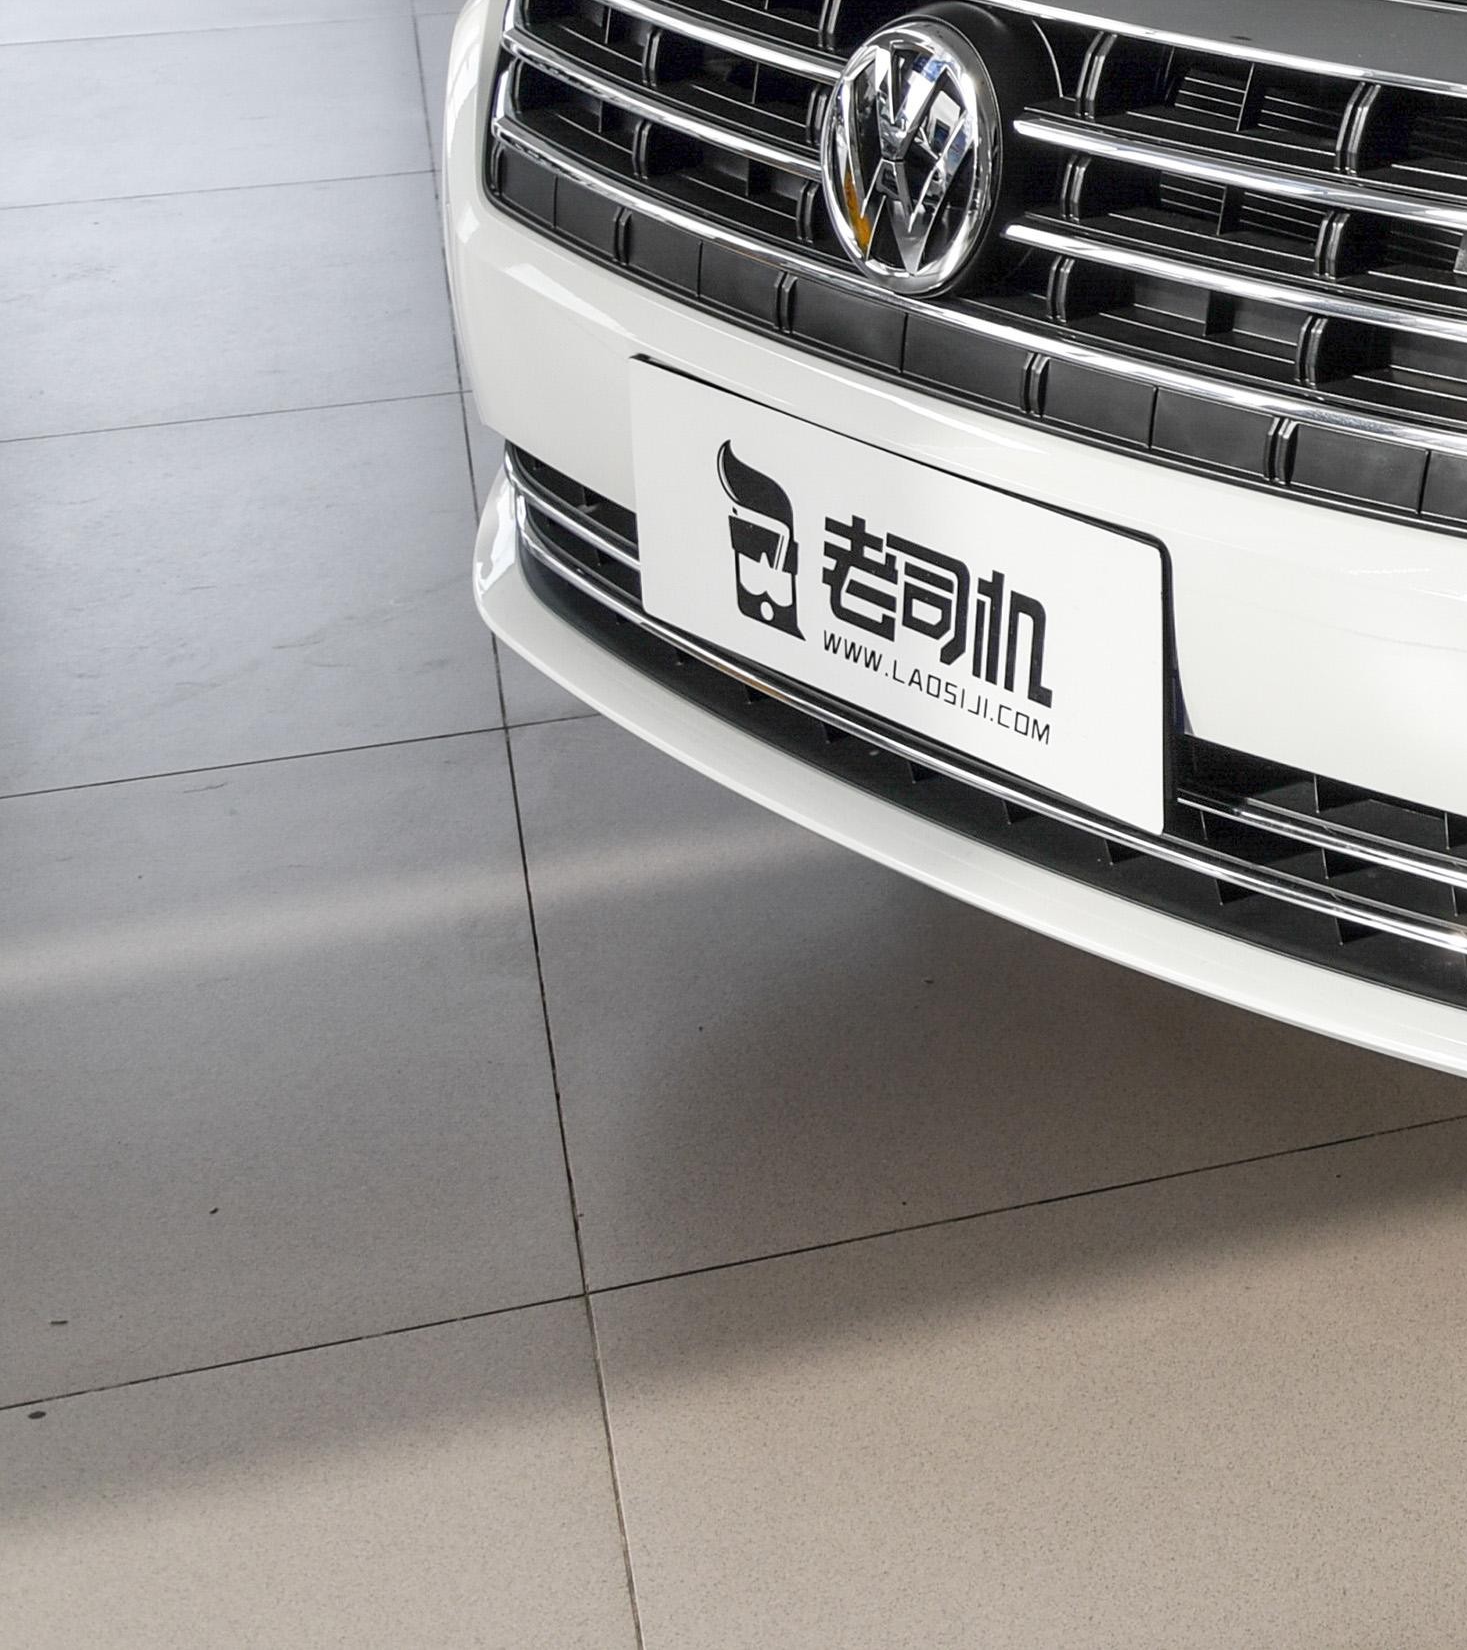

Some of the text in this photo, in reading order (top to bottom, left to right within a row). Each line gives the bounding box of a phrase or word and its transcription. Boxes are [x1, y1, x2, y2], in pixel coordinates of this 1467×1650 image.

[822, 515, 1053, 708] 老司机
[822, 629, 1052, 745] WWW.LAOSIJI.COM
